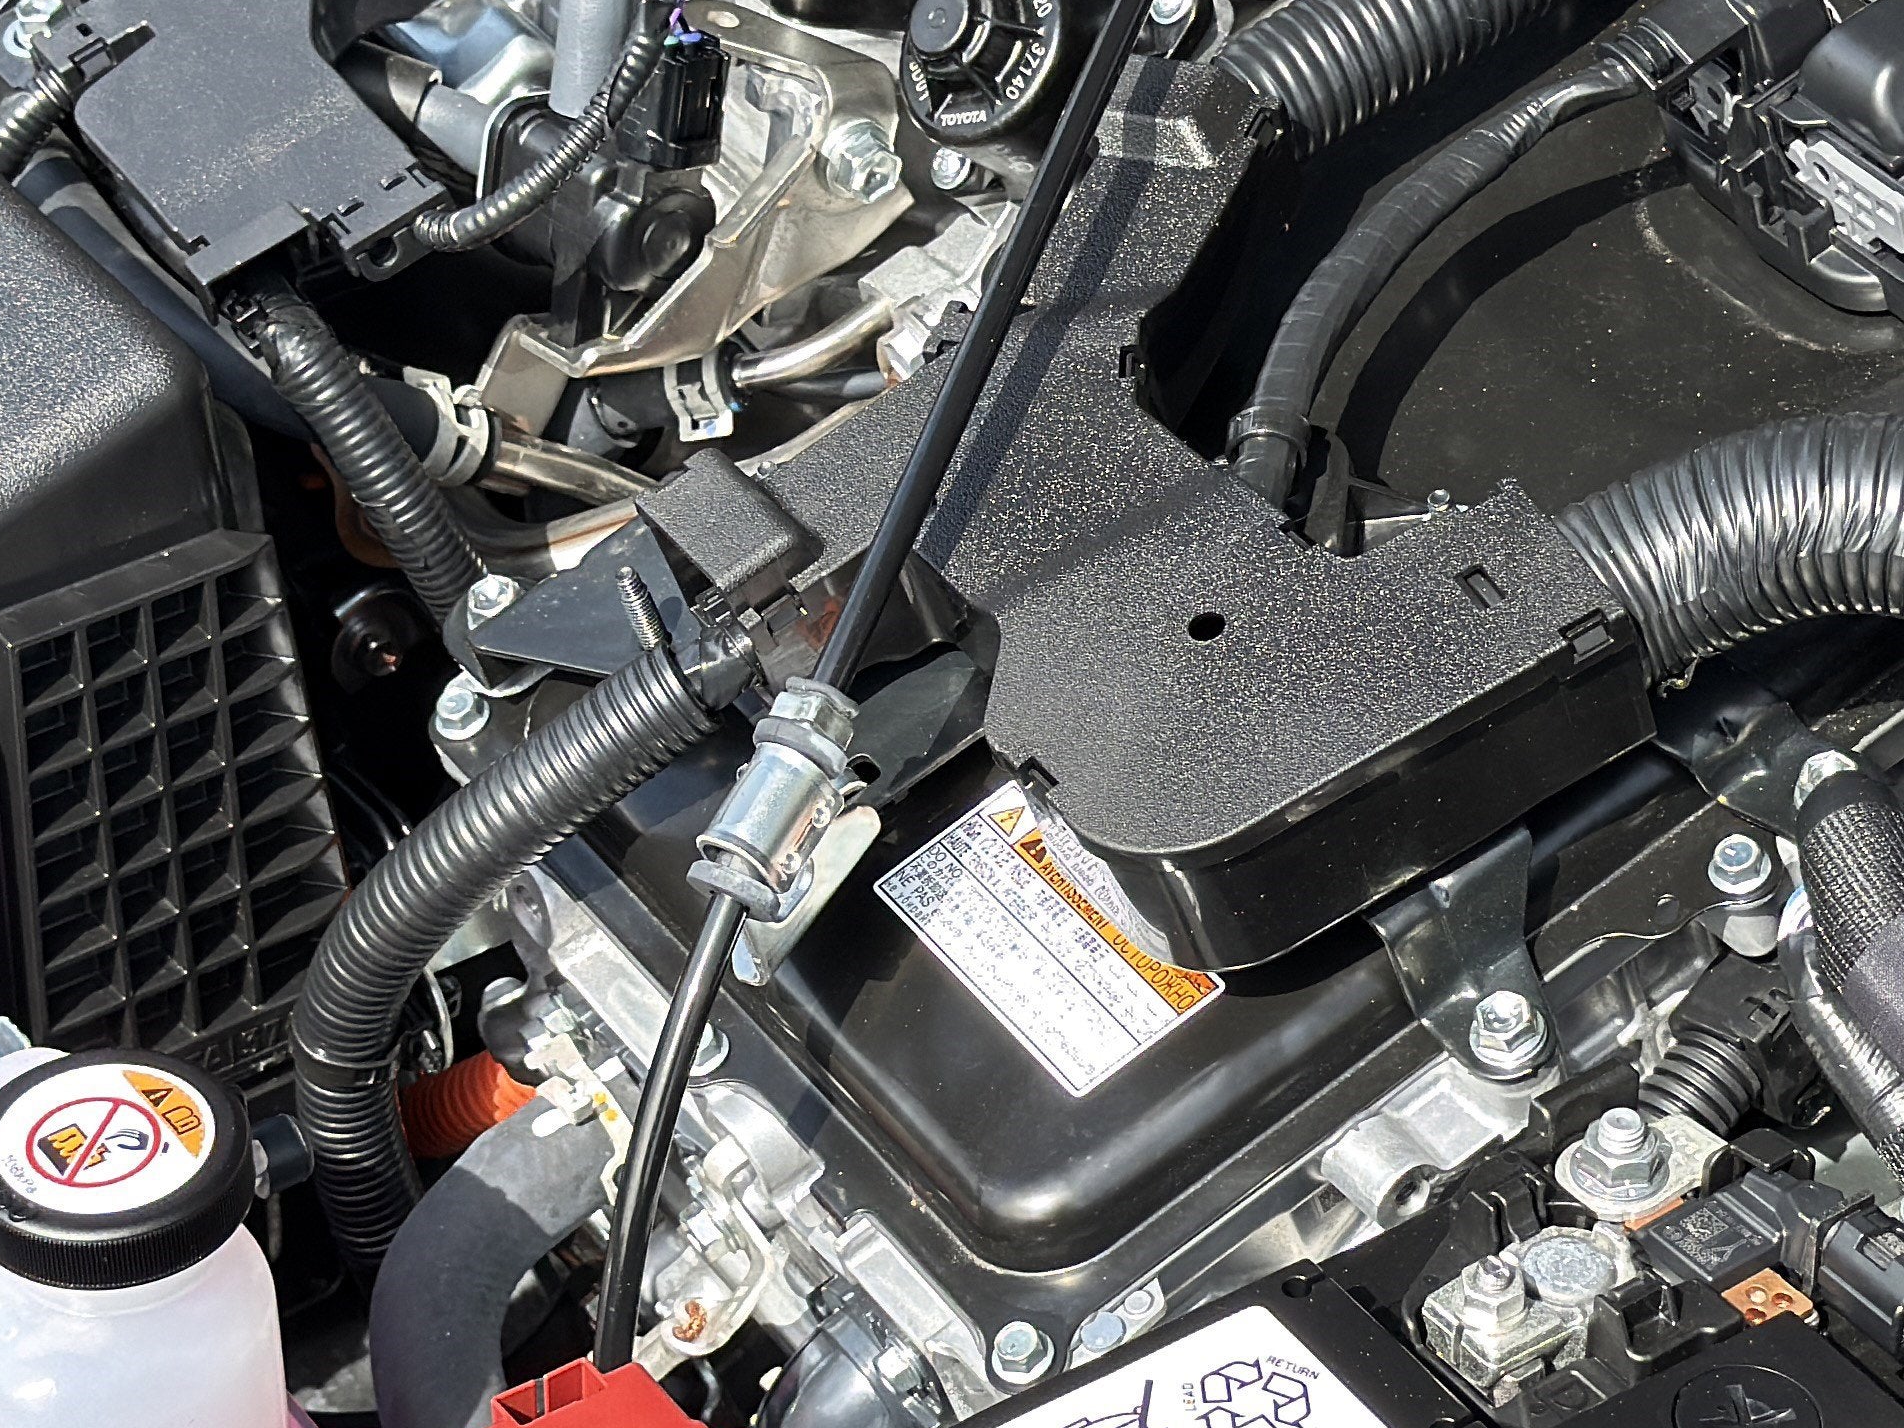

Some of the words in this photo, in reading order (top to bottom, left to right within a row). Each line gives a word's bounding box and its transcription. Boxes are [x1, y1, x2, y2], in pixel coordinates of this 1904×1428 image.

[1005, 41, 1046, 100] 37140
[940, 109, 987, 127] TOYOTA
[1265, 1354, 1321, 1381] RETURN
[1182, 1382, 1197, 1412] LEAD
